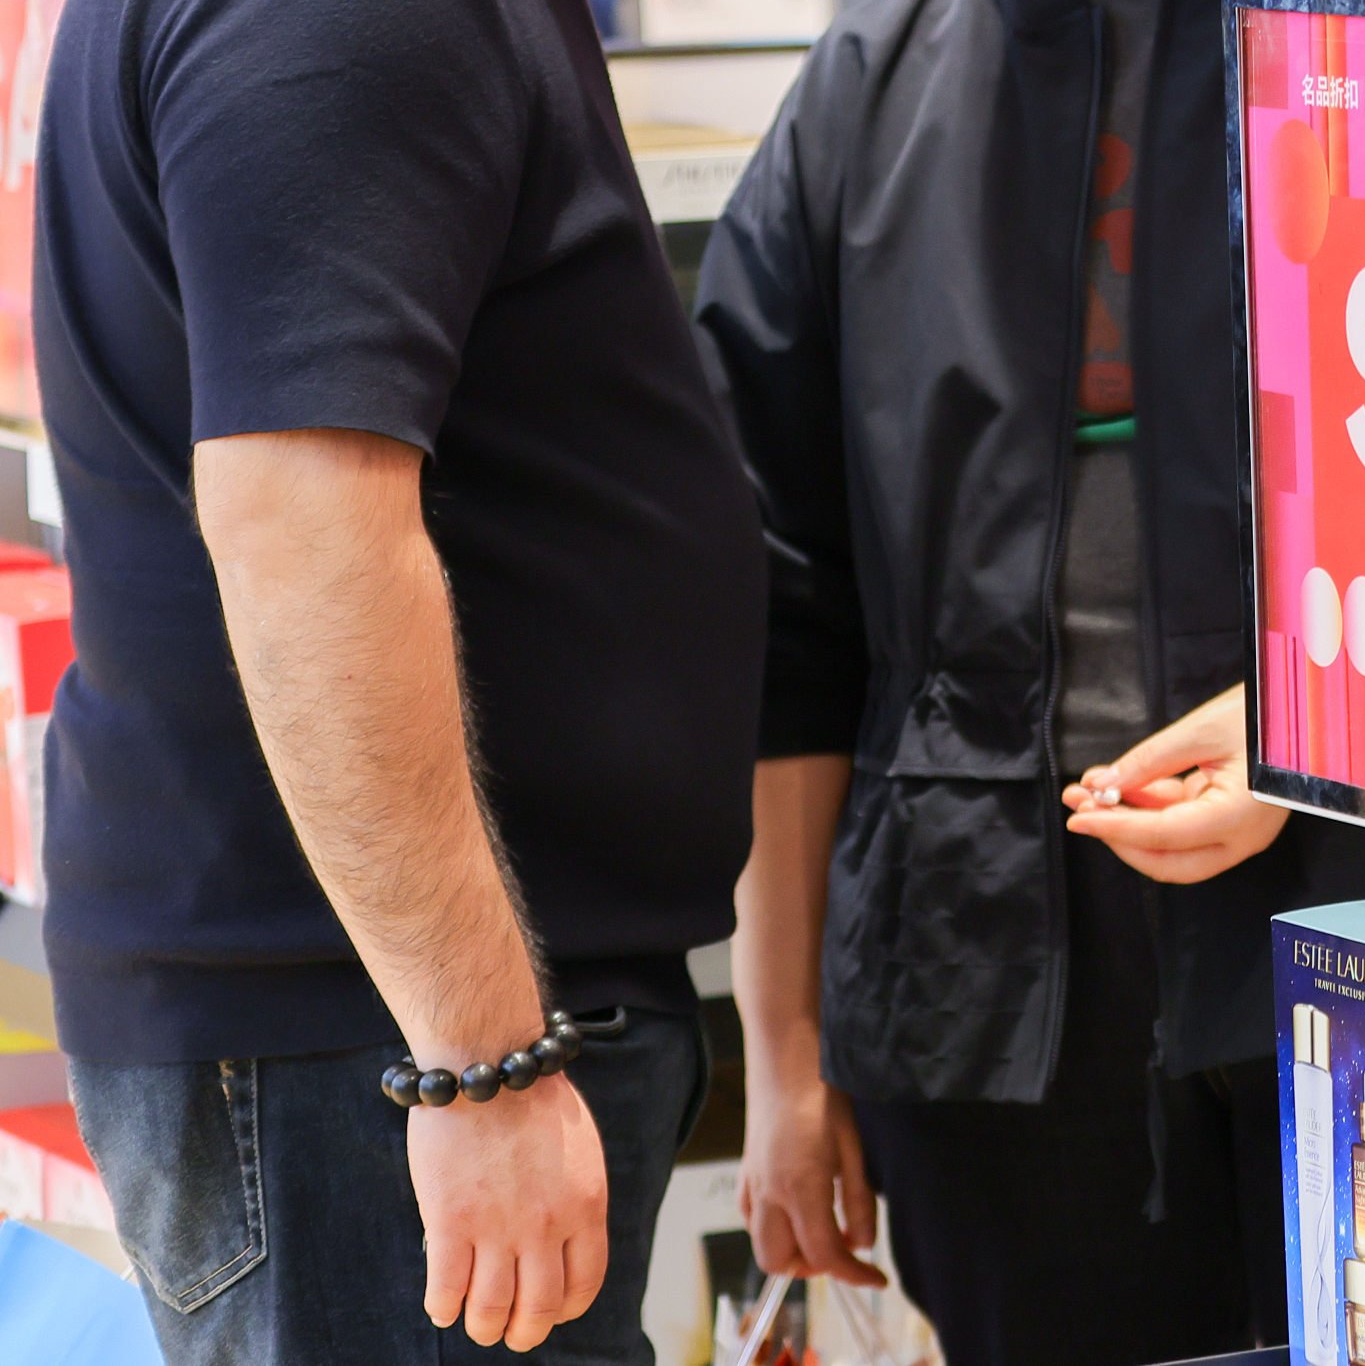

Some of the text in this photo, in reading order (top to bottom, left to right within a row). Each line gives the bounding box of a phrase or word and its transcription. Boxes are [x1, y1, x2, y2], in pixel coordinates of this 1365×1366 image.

[1301, 73, 1358, 110] 名品折扣
[1294, 939, 1333, 974] ESTÉE
[1314, 977, 1336, 993] TRAVEL
